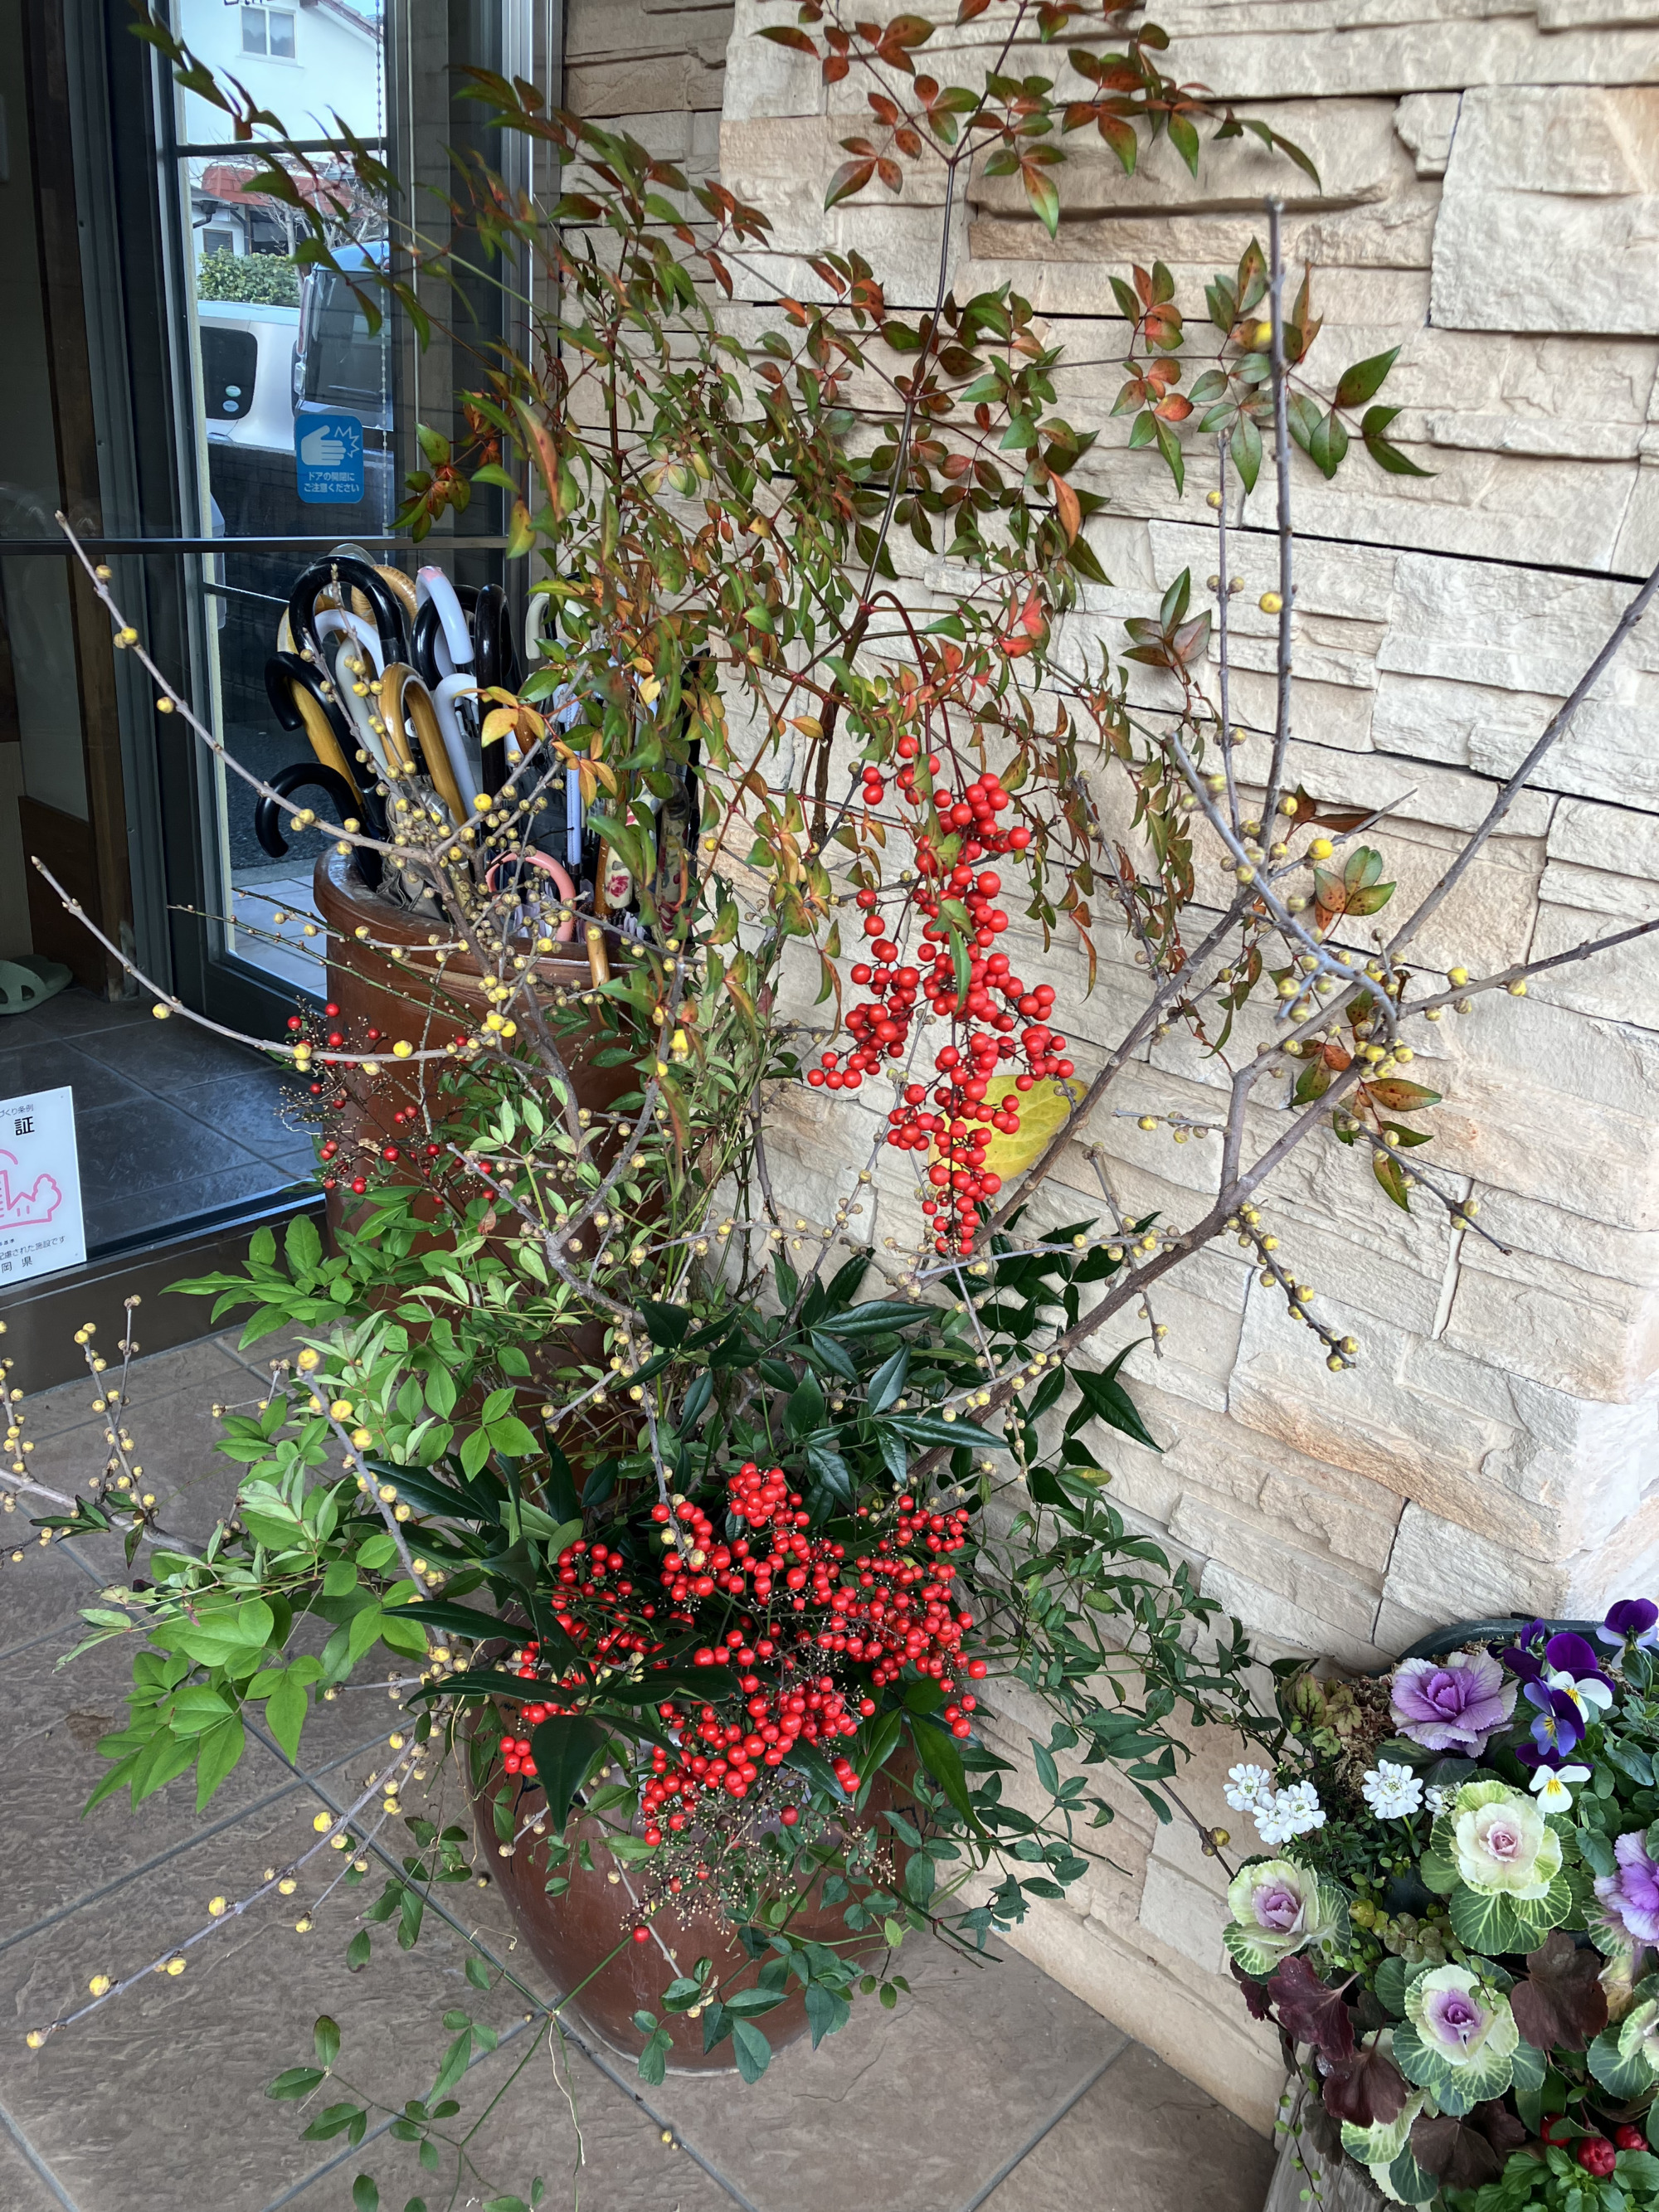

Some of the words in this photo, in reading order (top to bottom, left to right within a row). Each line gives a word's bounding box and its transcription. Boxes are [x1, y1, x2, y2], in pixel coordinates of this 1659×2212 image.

[309, 471, 355, 481] ドアの開閉に
[304, 483, 359, 493] ご注意ください
[14, 1116, 35, 1135] 証
